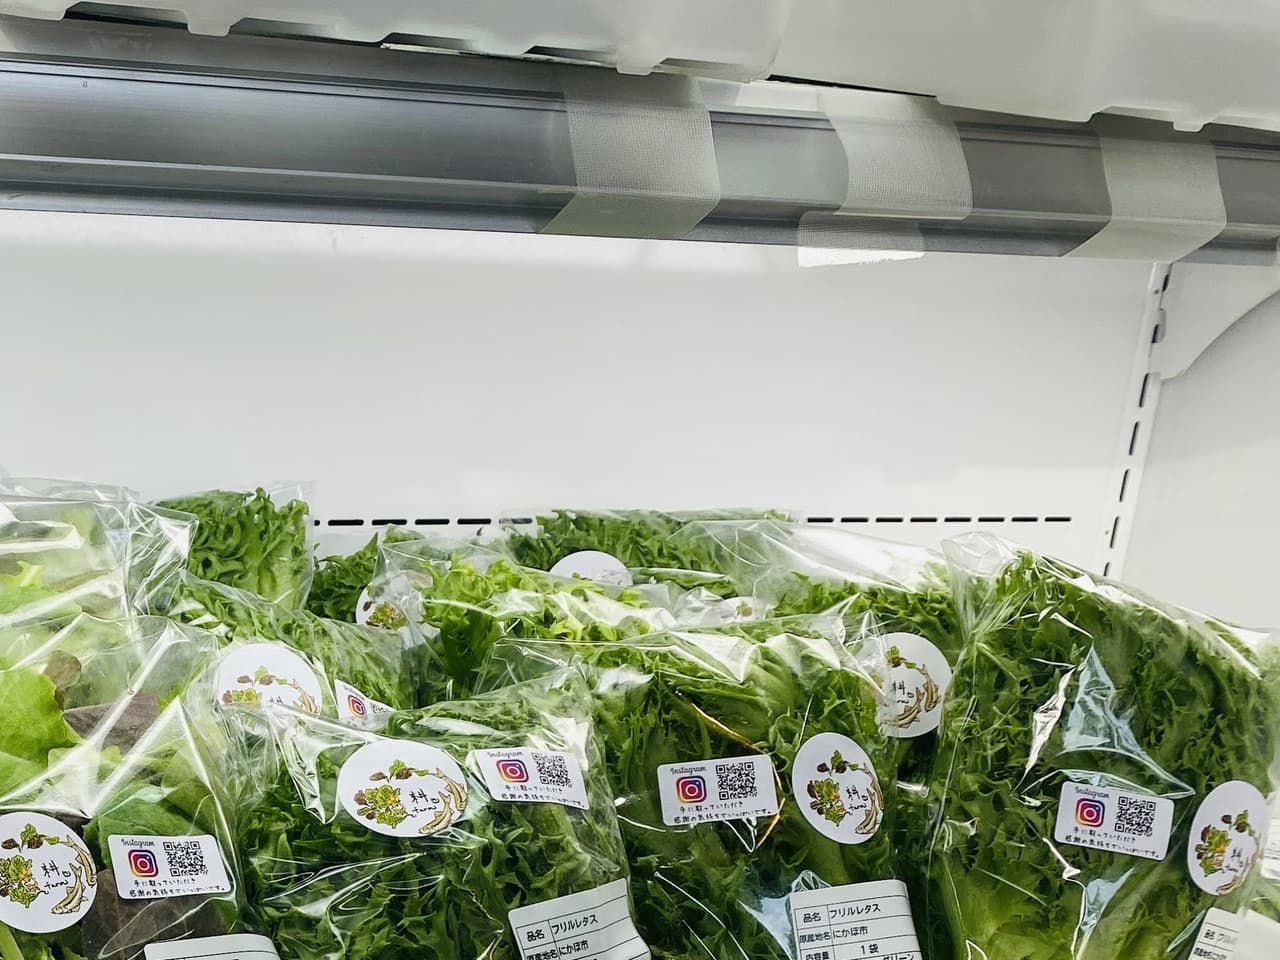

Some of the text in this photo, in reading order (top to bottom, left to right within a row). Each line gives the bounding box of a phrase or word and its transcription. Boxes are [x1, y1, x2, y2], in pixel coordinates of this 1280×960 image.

[121, 838, 155, 848] Instagram
[803, 904, 880, 923] 品名 フリルレタス
[526, 914, 598, 942] 品名 フリルレタス
[833, 926, 868, 939] にかほ市
[560, 940, 589, 956] にかほ市
